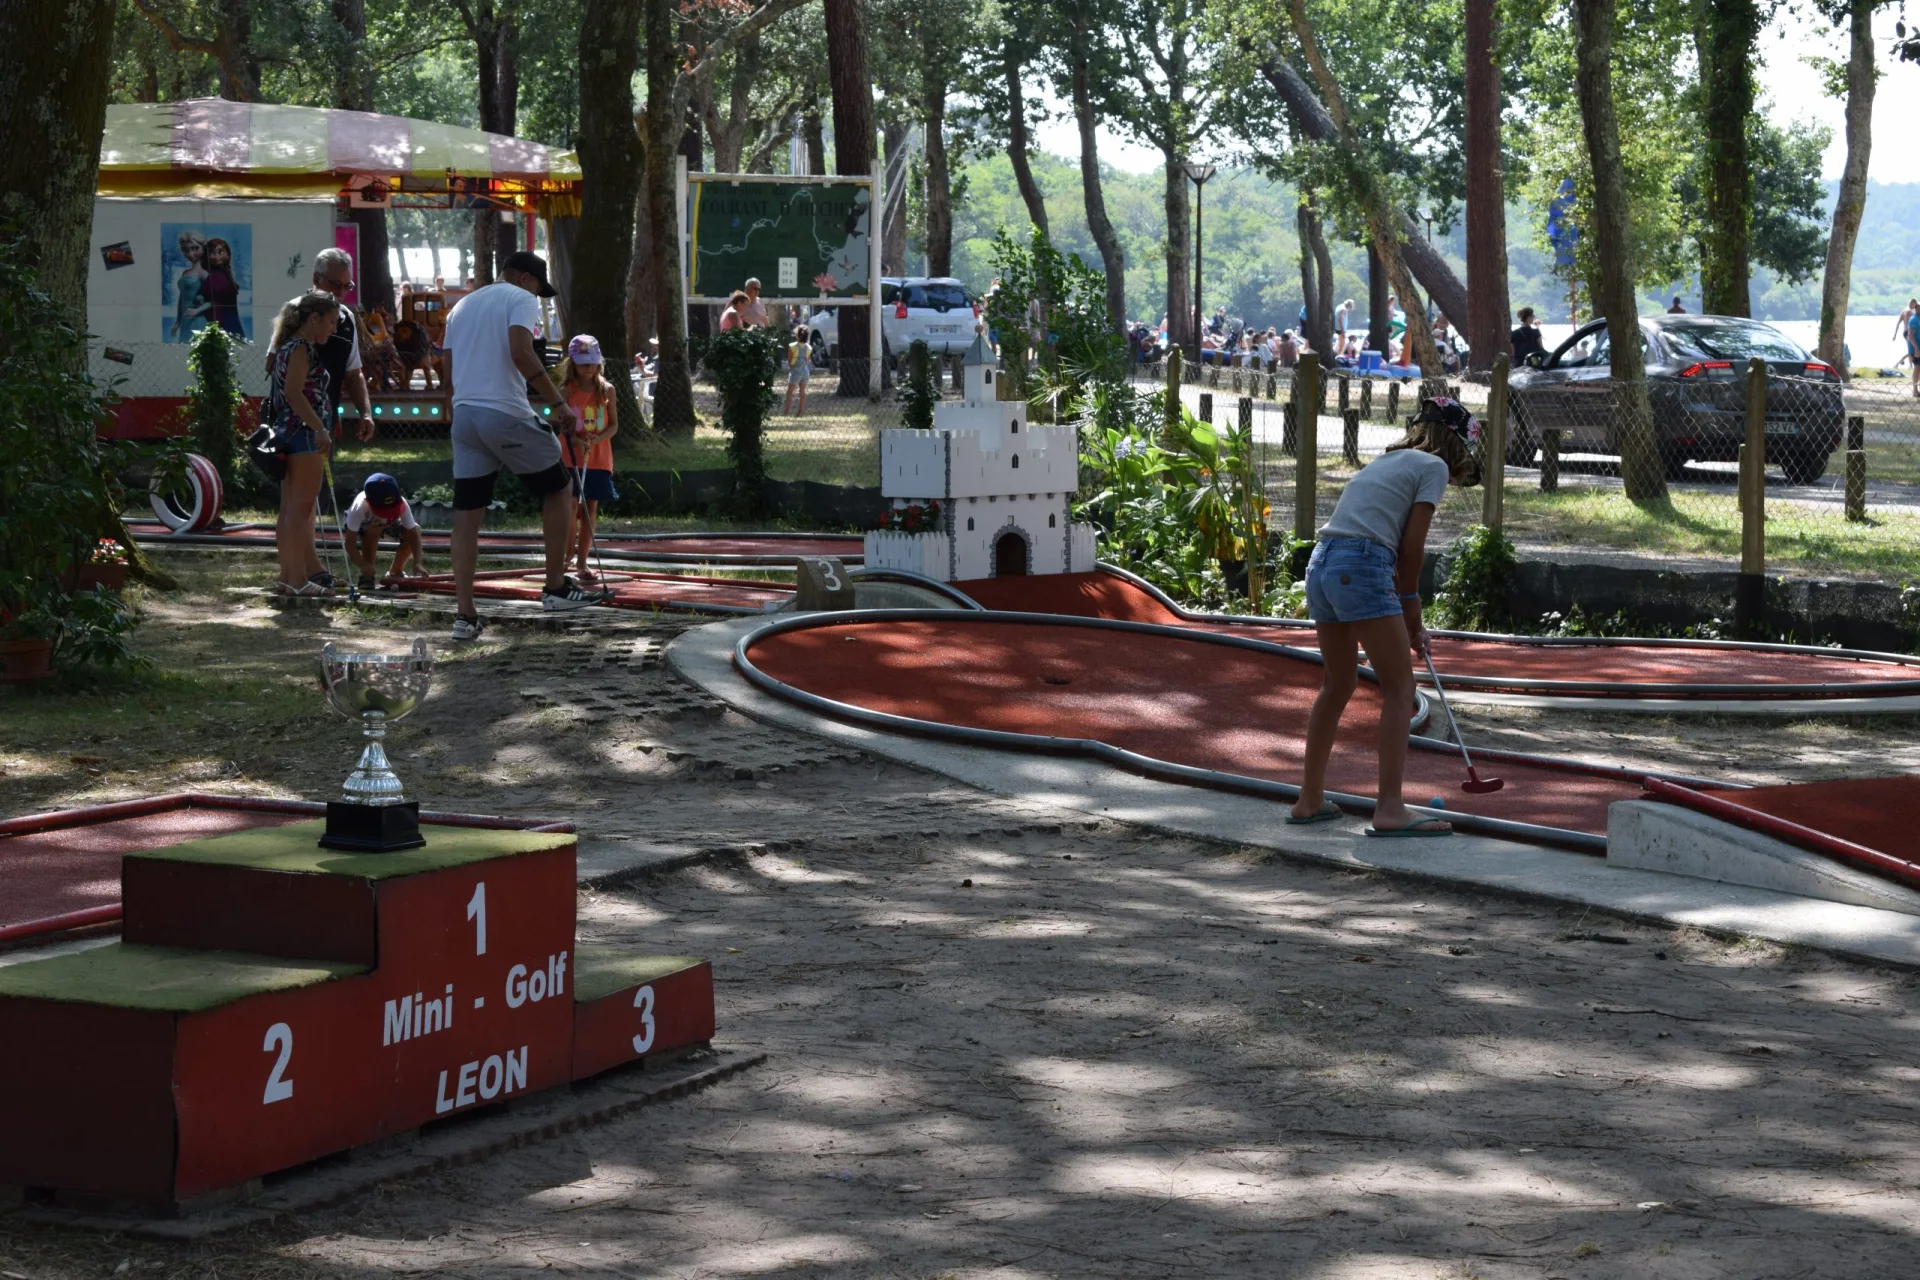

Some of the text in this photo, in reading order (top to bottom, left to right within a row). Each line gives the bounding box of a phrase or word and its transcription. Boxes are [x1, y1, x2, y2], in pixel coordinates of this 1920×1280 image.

[701, 198, 769, 216] COURANT
[818, 559, 842, 591] 3
[467, 881, 487, 956] 1
[383, 983, 453, 1047] Mini
[505, 950, 568, 1009] Golf
[632, 985, 656, 1054] 3
[263, 1021, 294, 1105] 2
[435, 1045, 528, 1115] LEON
